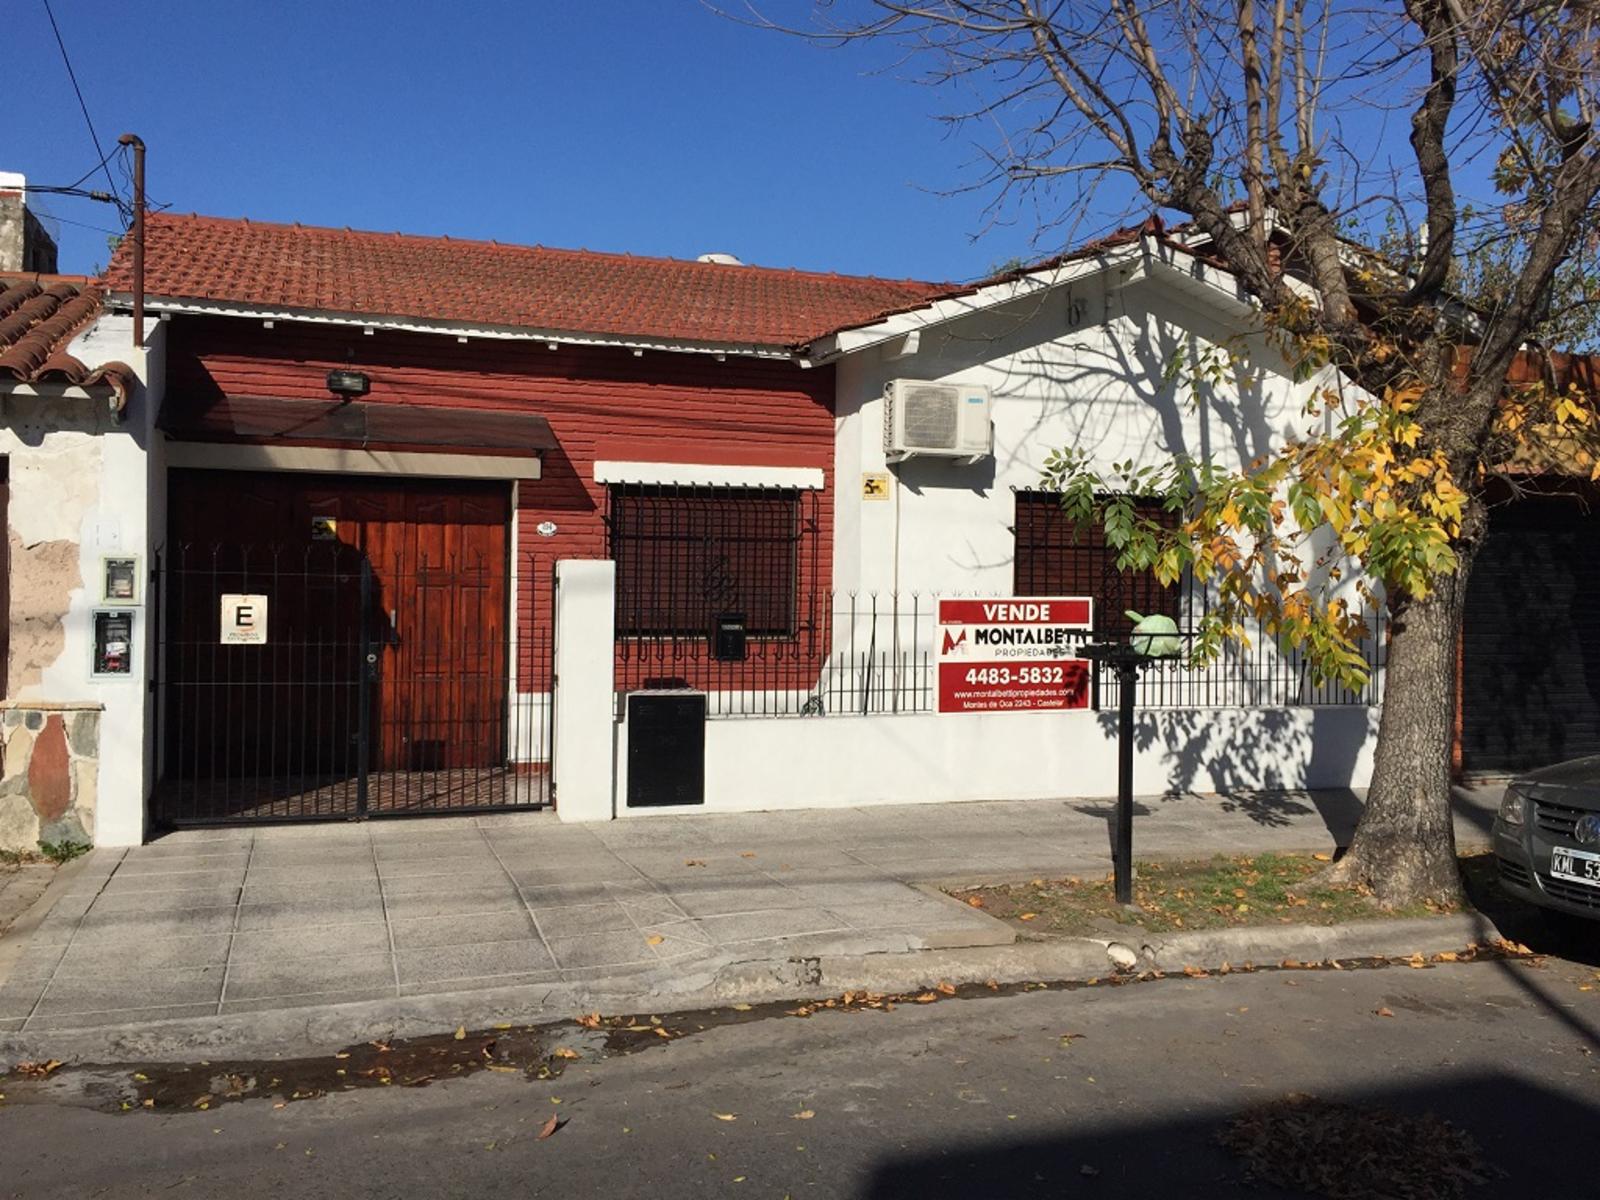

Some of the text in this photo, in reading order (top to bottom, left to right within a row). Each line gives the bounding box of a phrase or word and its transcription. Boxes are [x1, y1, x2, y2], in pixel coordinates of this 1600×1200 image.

[236, 606, 253, 626] E
[983, 604, 1051, 622] VENDE
[965, 668, 1063, 685] 4483-5832
[999, 700, 1013, 708] Oca
[1554, 854, 1577, 875] KML
